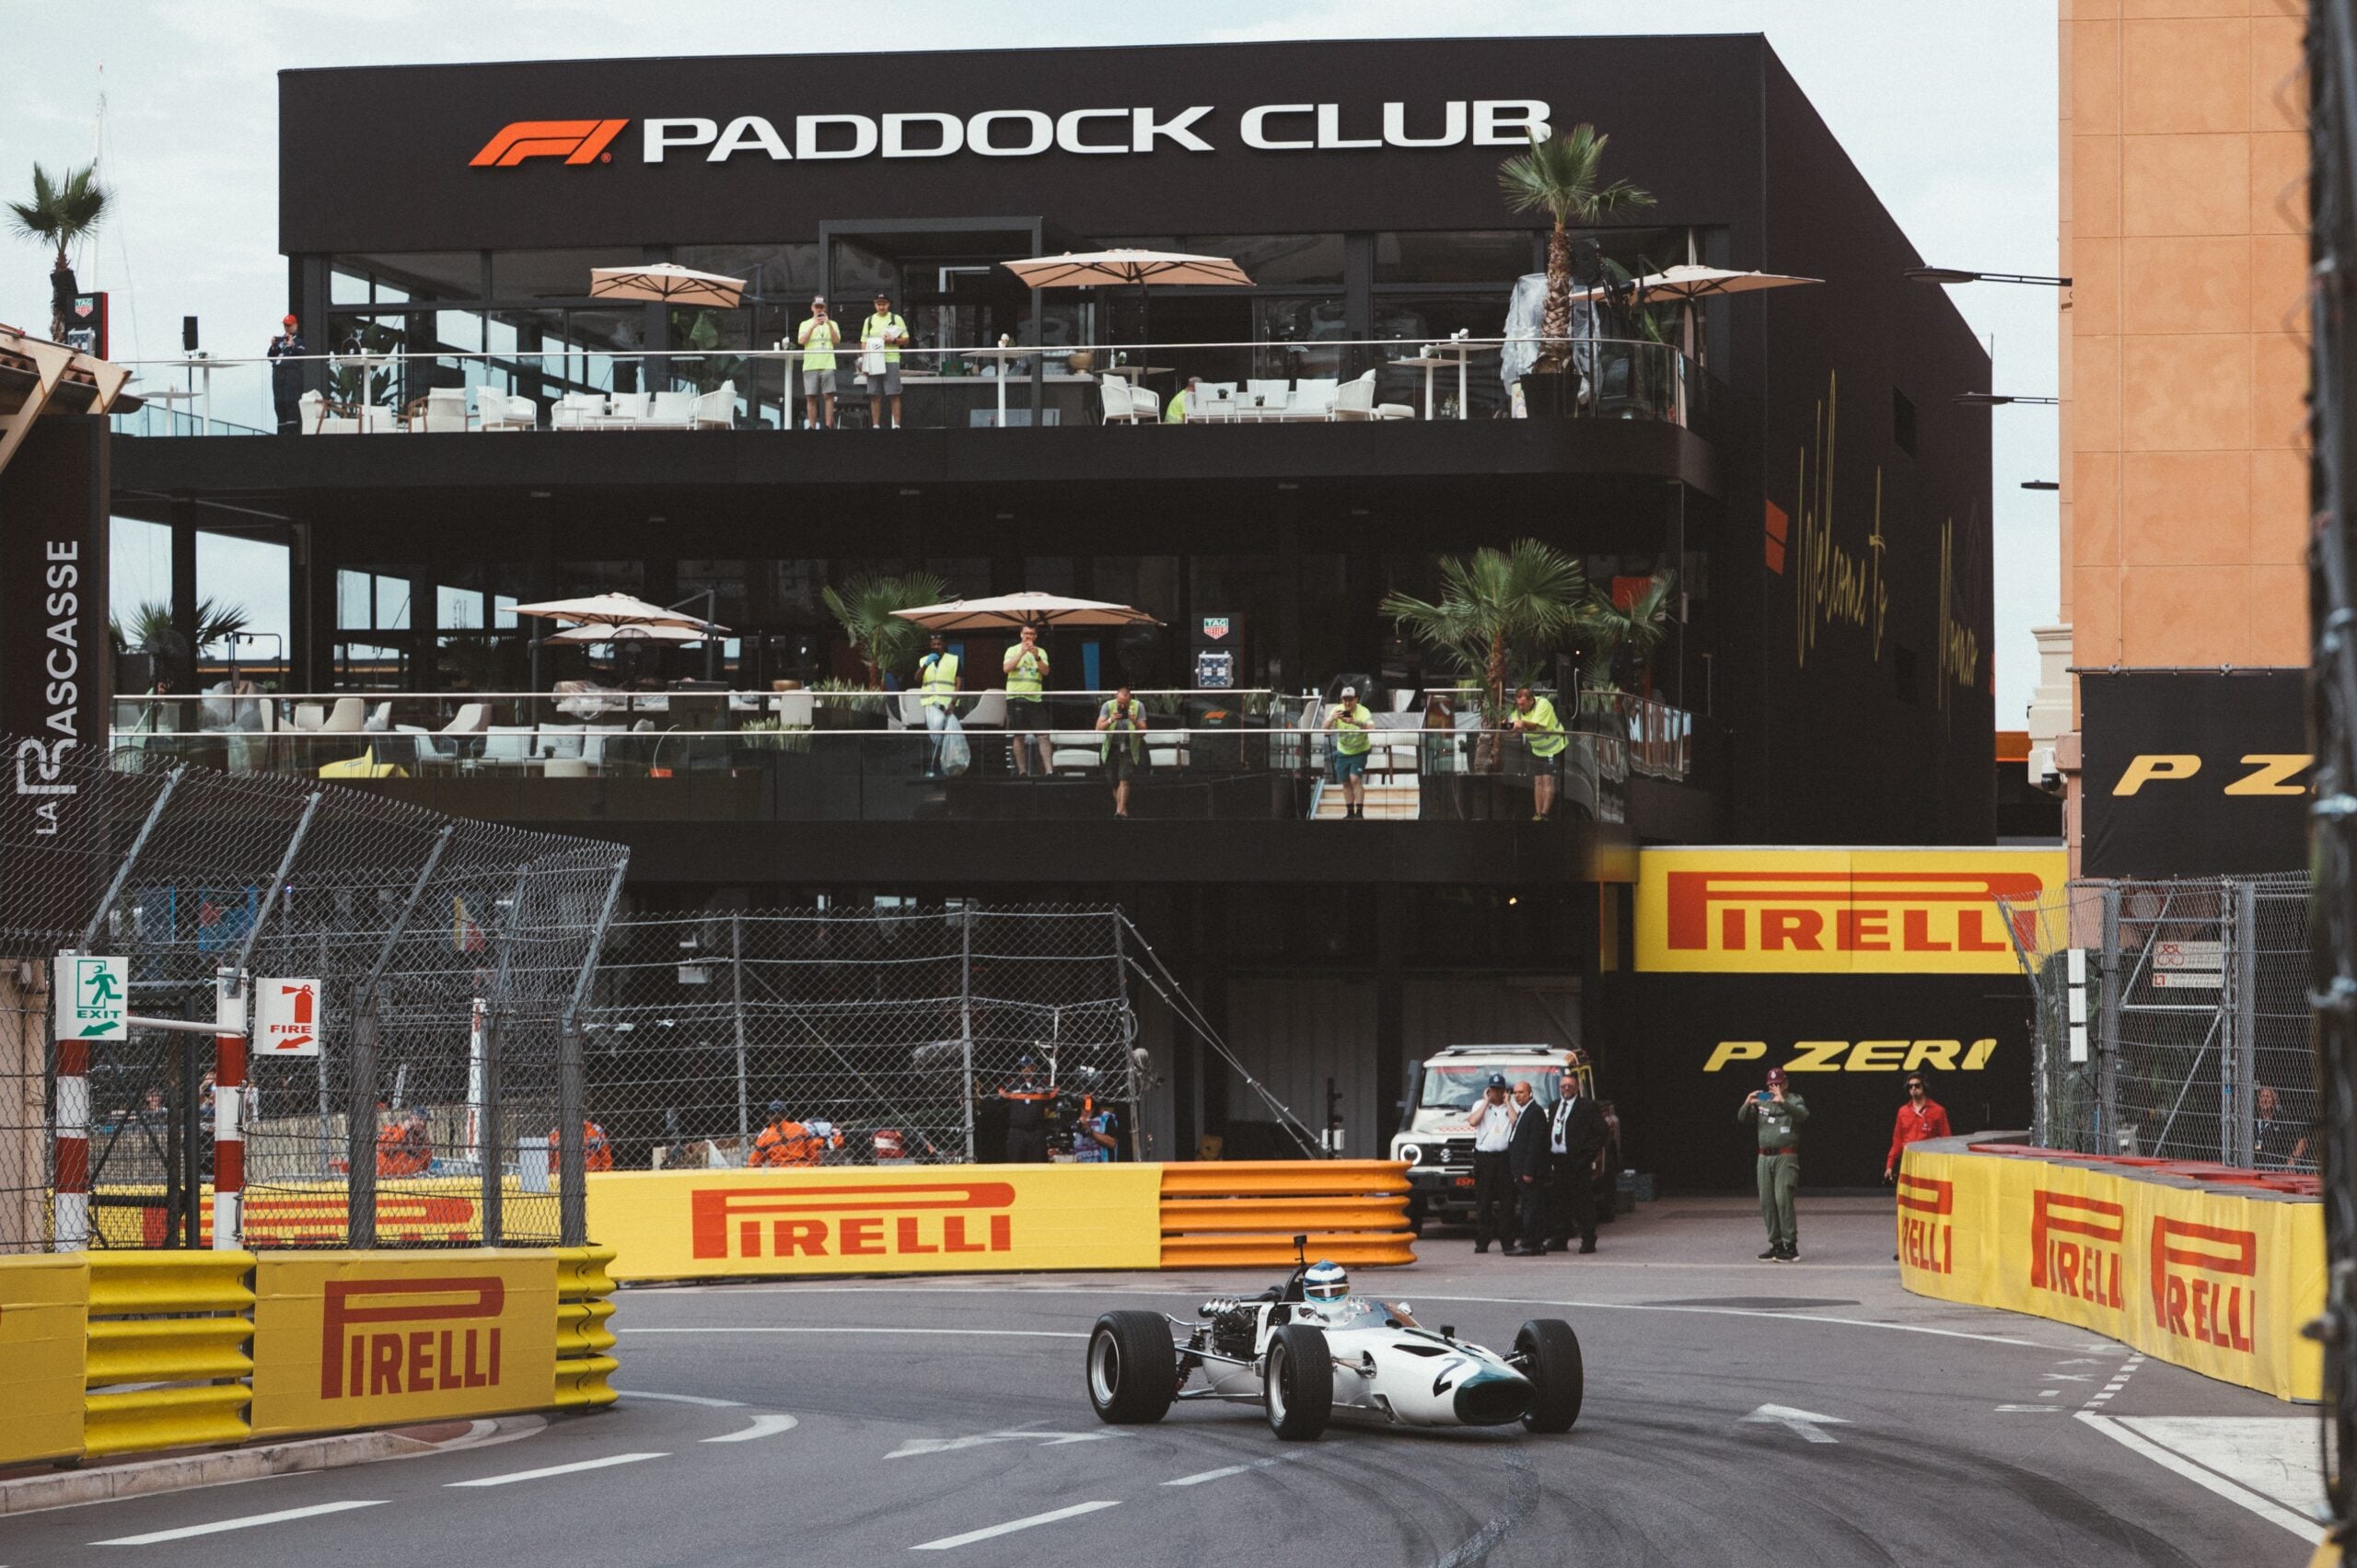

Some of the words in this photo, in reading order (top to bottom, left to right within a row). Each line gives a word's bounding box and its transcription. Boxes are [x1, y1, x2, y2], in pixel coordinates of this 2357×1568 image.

[644, 106, 1215, 163] PADDOCK
[1240, 99, 1552, 149] CLUB
[1206, 619, 1226, 627] TAG
[17, 540, 78, 795] RASCASSE
[2112, 754, 2202, 796] P
[2223, 754, 2316, 796] Z
[36, 800, 57, 835] LA
[1667, 871, 2043, 952] PIRELLI
[76, 1009, 122, 1019] EXIT
[270, 1024, 313, 1034] FIRE
[1702, 1040, 1768, 1072] P
[691, 1182, 1016, 1260] PIRELLI
[320, 1276, 505, 1400] PIRELLI
[1433, 1356, 1468, 1398] 2
